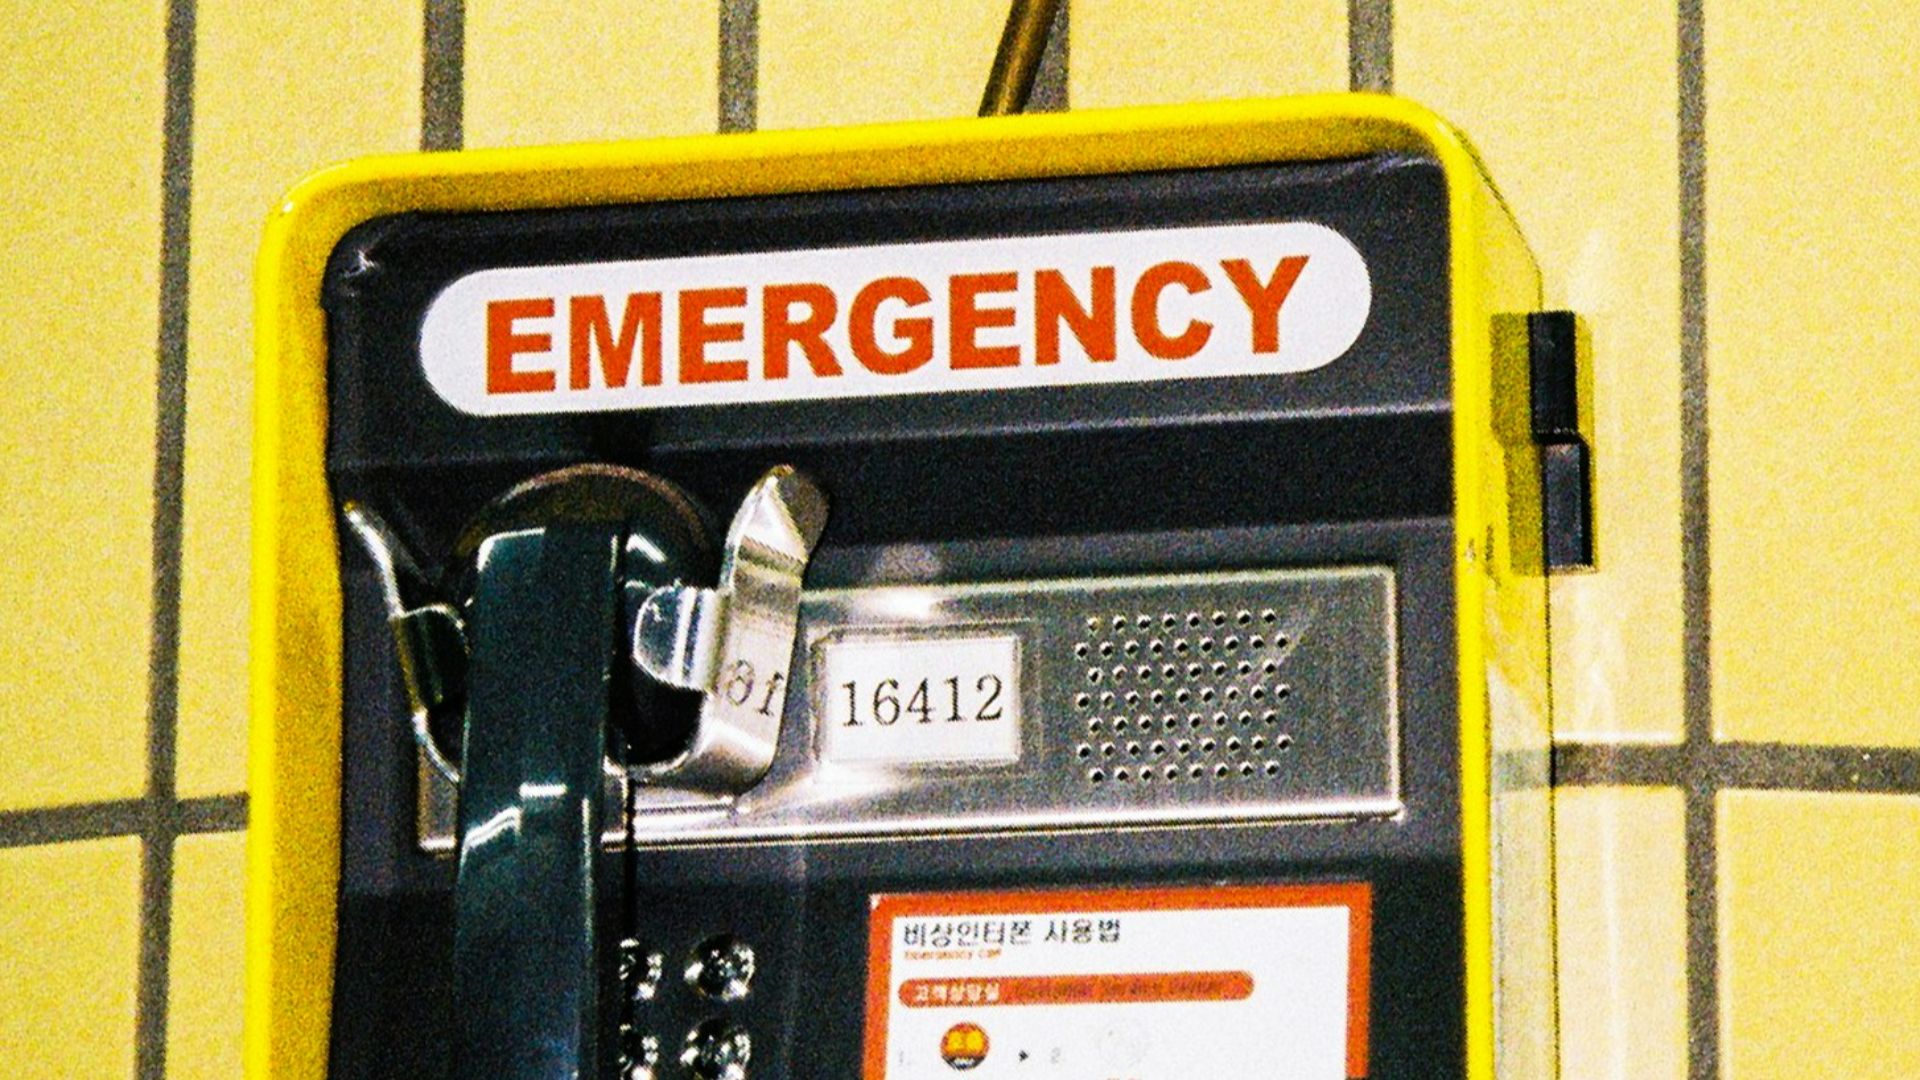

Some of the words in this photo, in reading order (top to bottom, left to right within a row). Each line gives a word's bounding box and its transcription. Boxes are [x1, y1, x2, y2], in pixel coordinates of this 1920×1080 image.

[486, 254, 1311, 394] EMERGENCY
[842, 674, 1003, 727] 16412
[904, 920, 1032, 947] 비상인터폰
[1044, 918, 1121, 944] 사용법
